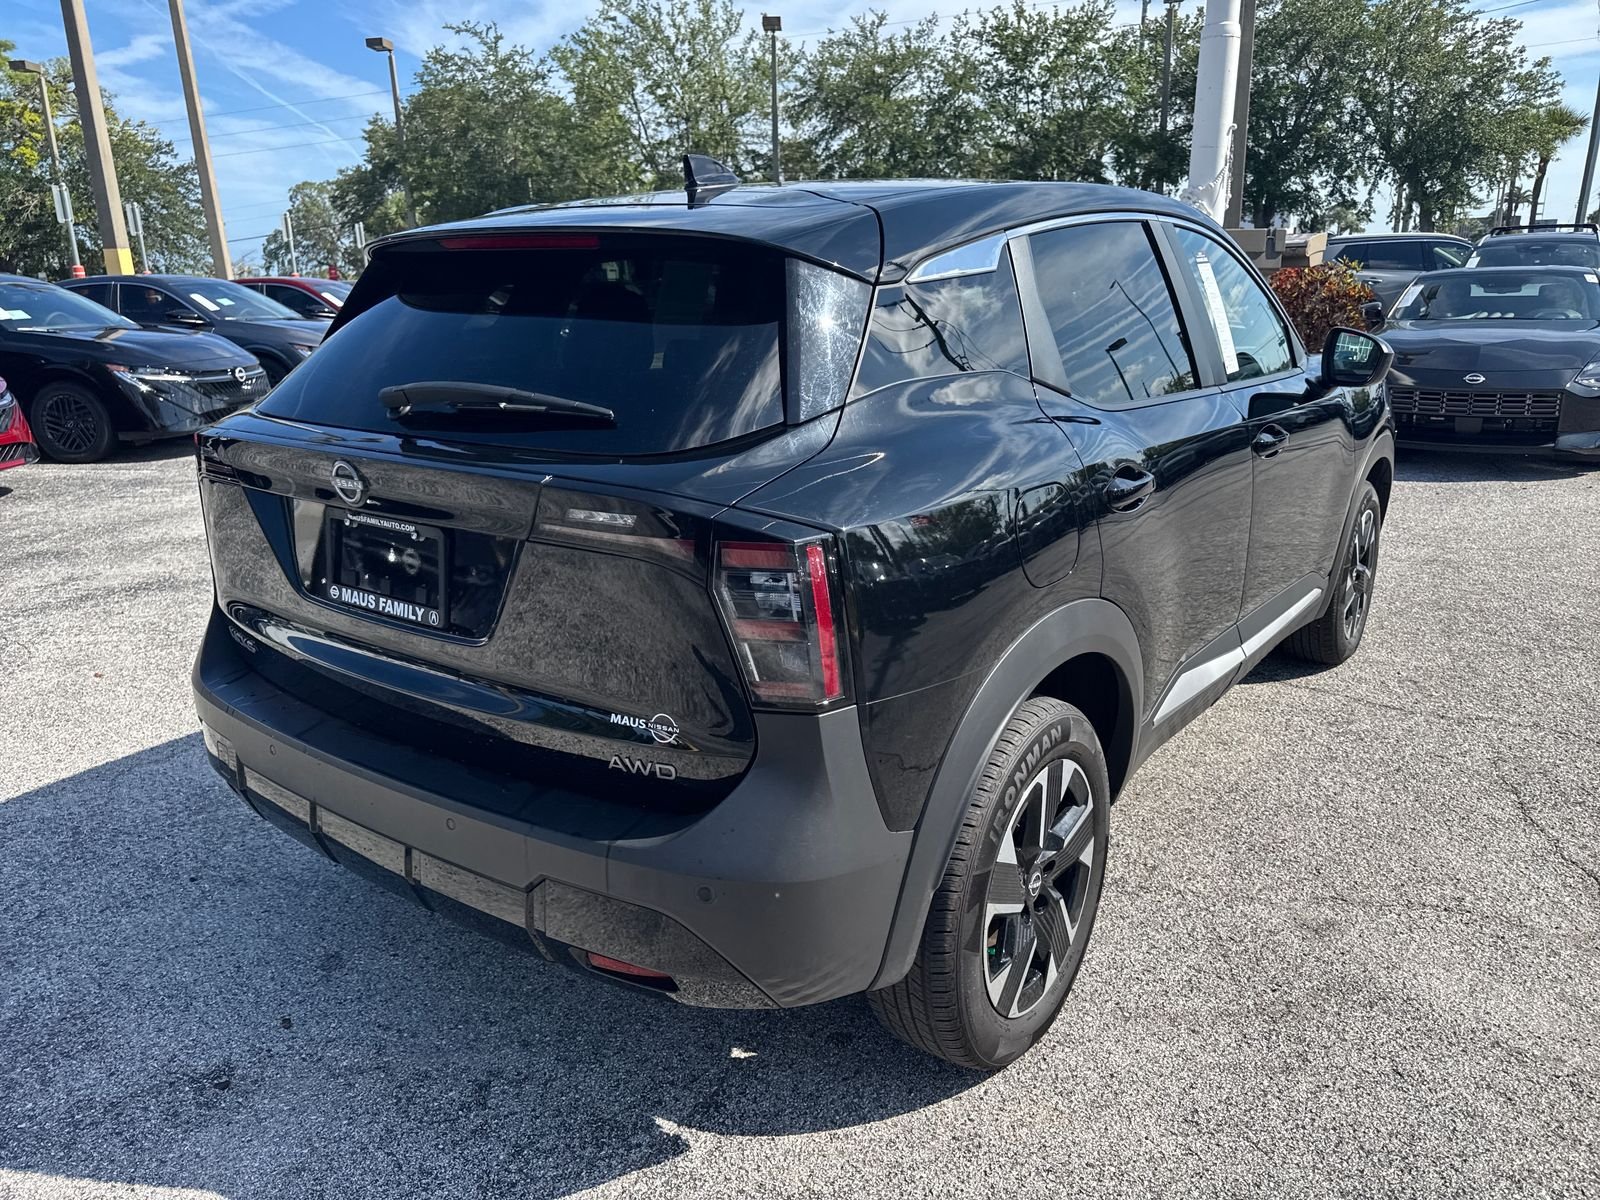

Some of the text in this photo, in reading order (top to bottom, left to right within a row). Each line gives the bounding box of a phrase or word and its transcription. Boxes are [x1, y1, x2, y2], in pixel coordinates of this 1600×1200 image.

[341, 587, 425, 622] MAUS FAMILY
[610, 713, 680, 733] MAUS NISSAN
[608, 756, 676, 780] AWD
[990, 725, 1061, 847] IRONMAN
